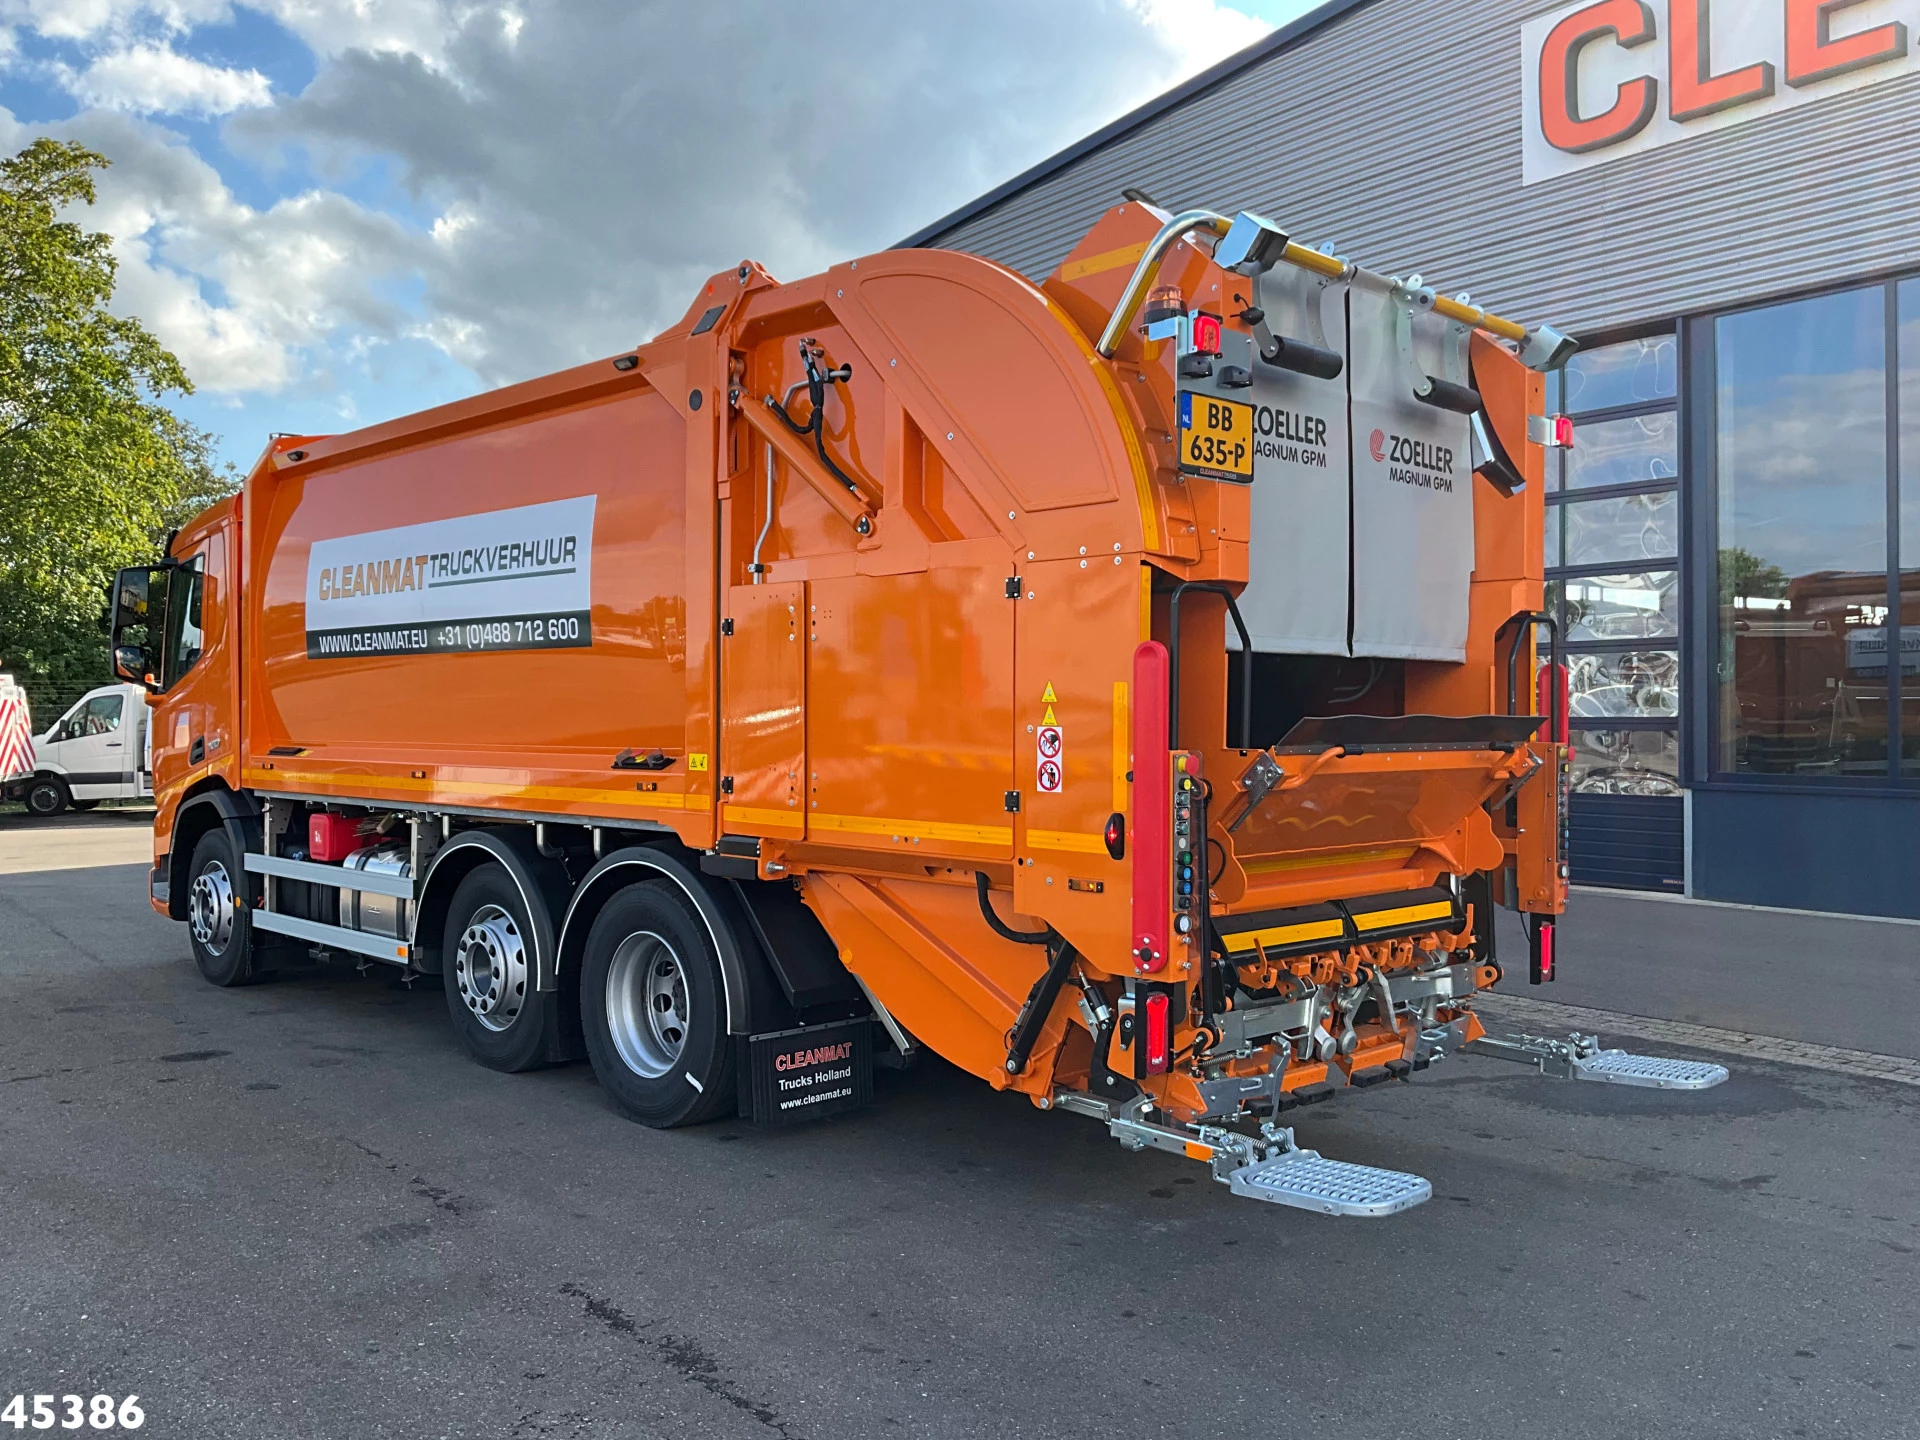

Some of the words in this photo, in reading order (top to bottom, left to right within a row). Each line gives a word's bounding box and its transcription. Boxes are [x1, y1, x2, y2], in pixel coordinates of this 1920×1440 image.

[1539, 0, 1920, 154] CLE
[1182, 414, 1191, 424] NL
[1207, 402, 1233, 432] BB
[1190, 434, 1245, 468] 635-P
[1254, 440, 1299, 463] AGNUM
[1301, 449, 1327, 468] GPM
[1389, 434, 1453, 475] ZOELLER
[1389, 466, 1432, 488] MAGNUM
[1433, 476, 1453, 493] GPM
[319, 629, 428, 654] WWW.CLEANMAT.EU
[437, 626, 462, 646] +31
[466, 622, 511, 649] (0)488
[514, 620, 544, 642] 712
[548, 617, 579, 640] 600
[775, 1042, 852, 1072] CLEANMAT
[779, 1076, 813, 1091] Trucks
[815, 1066, 851, 1084] Holland
[780, 1087, 852, 1110] www.cleanmat.eu
